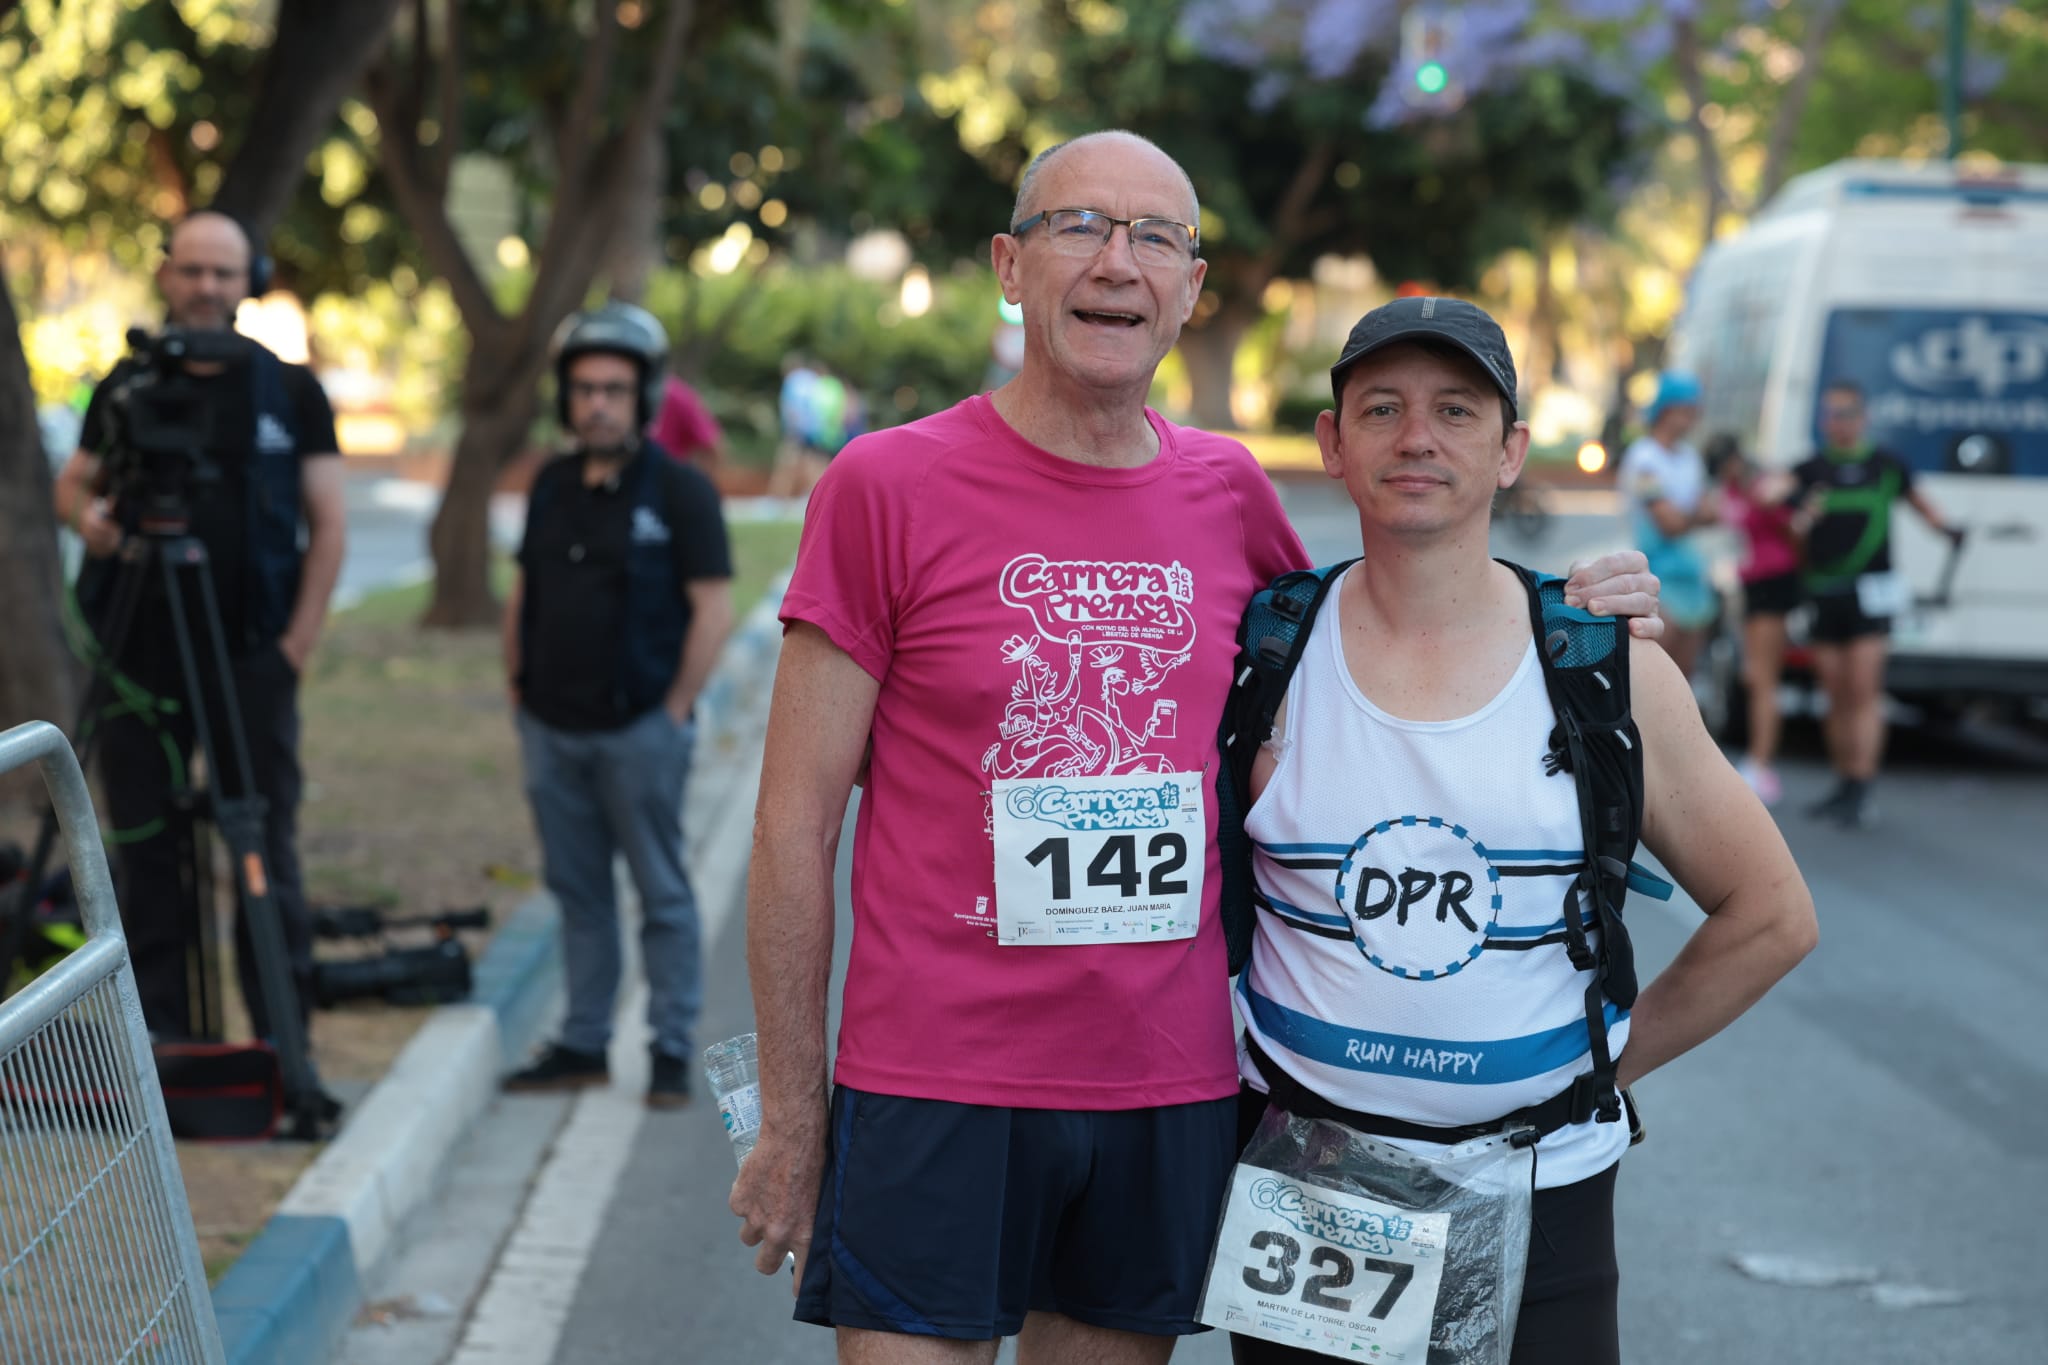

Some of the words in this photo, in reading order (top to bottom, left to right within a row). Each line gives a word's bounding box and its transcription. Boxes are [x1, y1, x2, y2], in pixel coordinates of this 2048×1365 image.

[1012, 562, 1169, 596] Carrera
[1169, 566, 1189, 583] de
[1046, 590, 1180, 625] Prensa
[1039, 786, 1160, 815] Carrera
[1063, 808, 1168, 830] Prensa
[1025, 832, 1188, 900] 142
[1127, 904, 1149, 913] JUAN
[1355, 867, 1478, 933] DPR
[1345, 1038, 1394, 1064] RUN
[1403, 1047, 1484, 1076] HAPPY
[1278, 1187, 1385, 1233] Carrera
[1298, 1213, 1389, 1254] Prensa
[1242, 1230, 1414, 1320] 327
[1291, 1308, 1303, 1318] DE
[1304, 1311, 1316, 1322] LA
